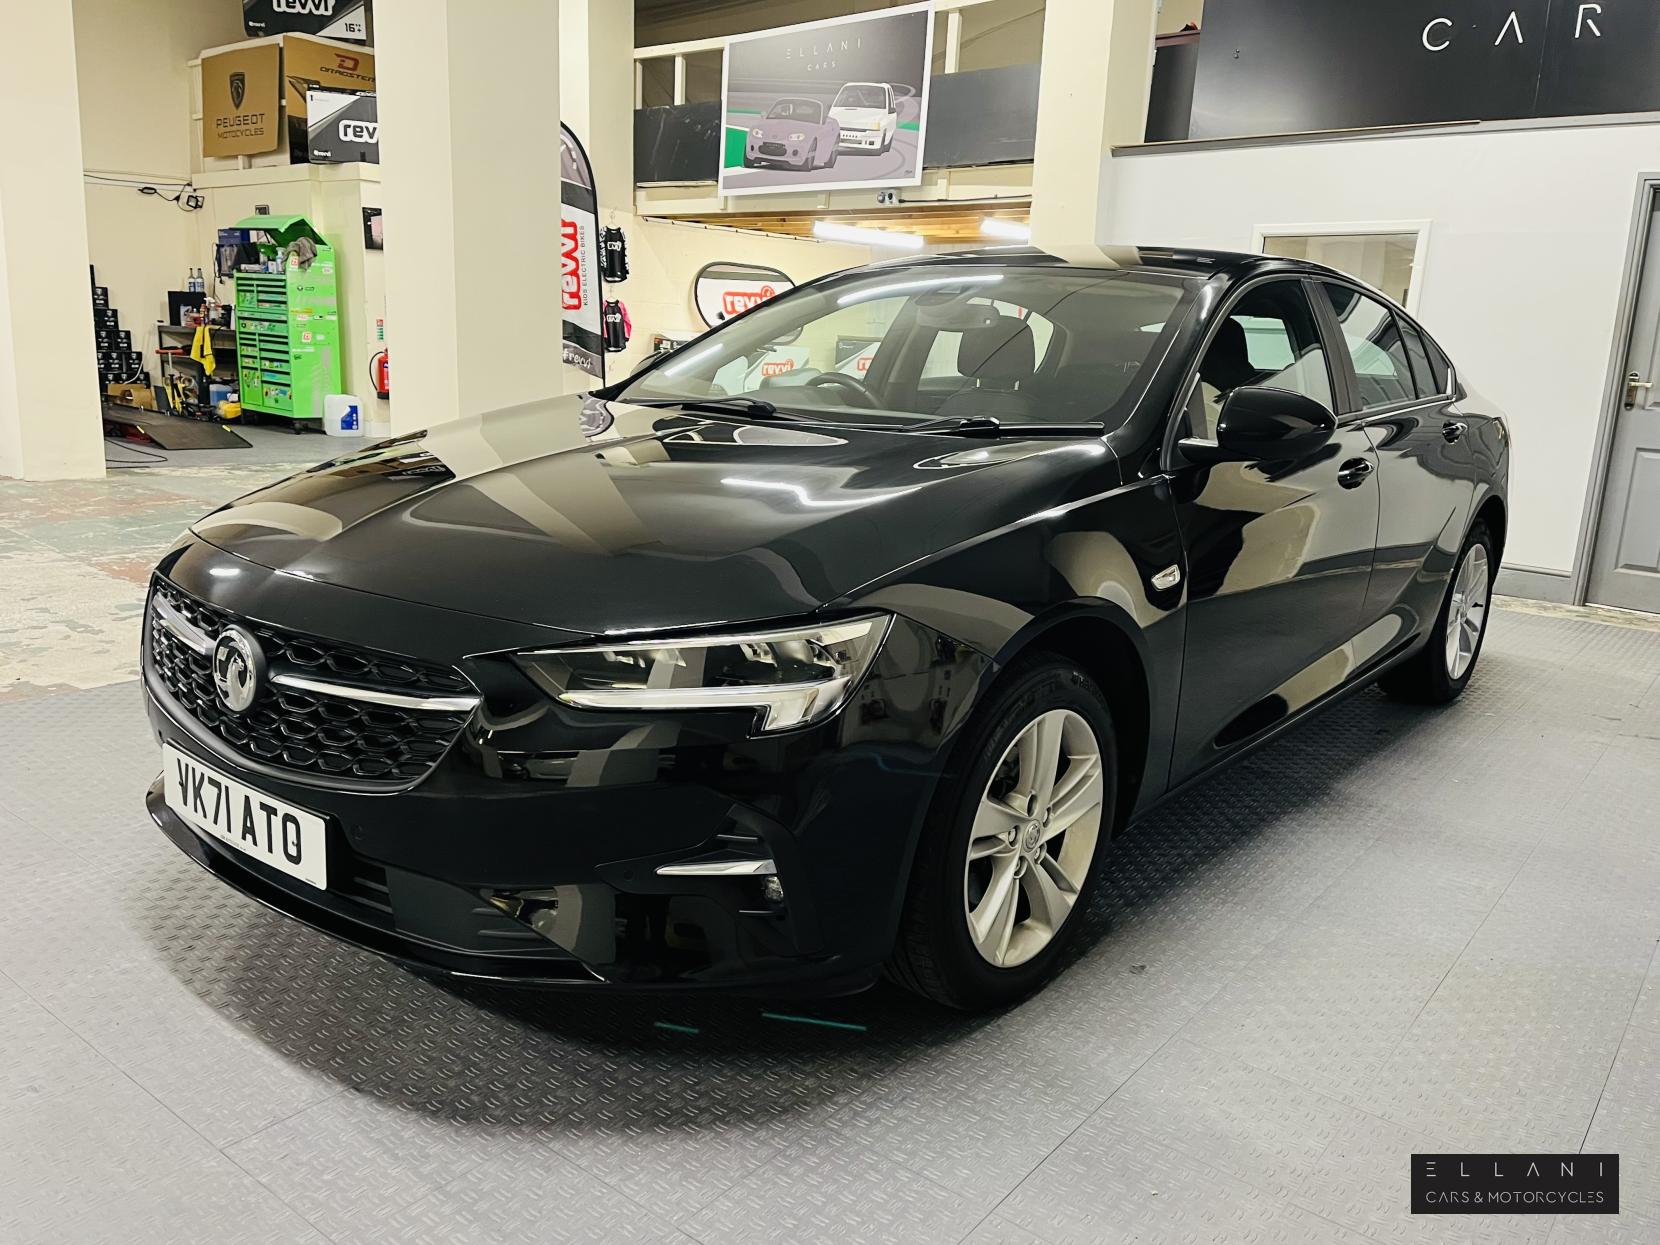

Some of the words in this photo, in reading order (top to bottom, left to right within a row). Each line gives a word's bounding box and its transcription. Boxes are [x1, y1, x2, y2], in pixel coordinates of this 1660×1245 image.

[1422, 4, 1602, 51] CAR
[784, 38, 861, 59] ELLANI
[216, 113, 265, 128] PEUGEOT
[177, 758, 231, 833] VK71
[241, 795, 302, 865] ATO
